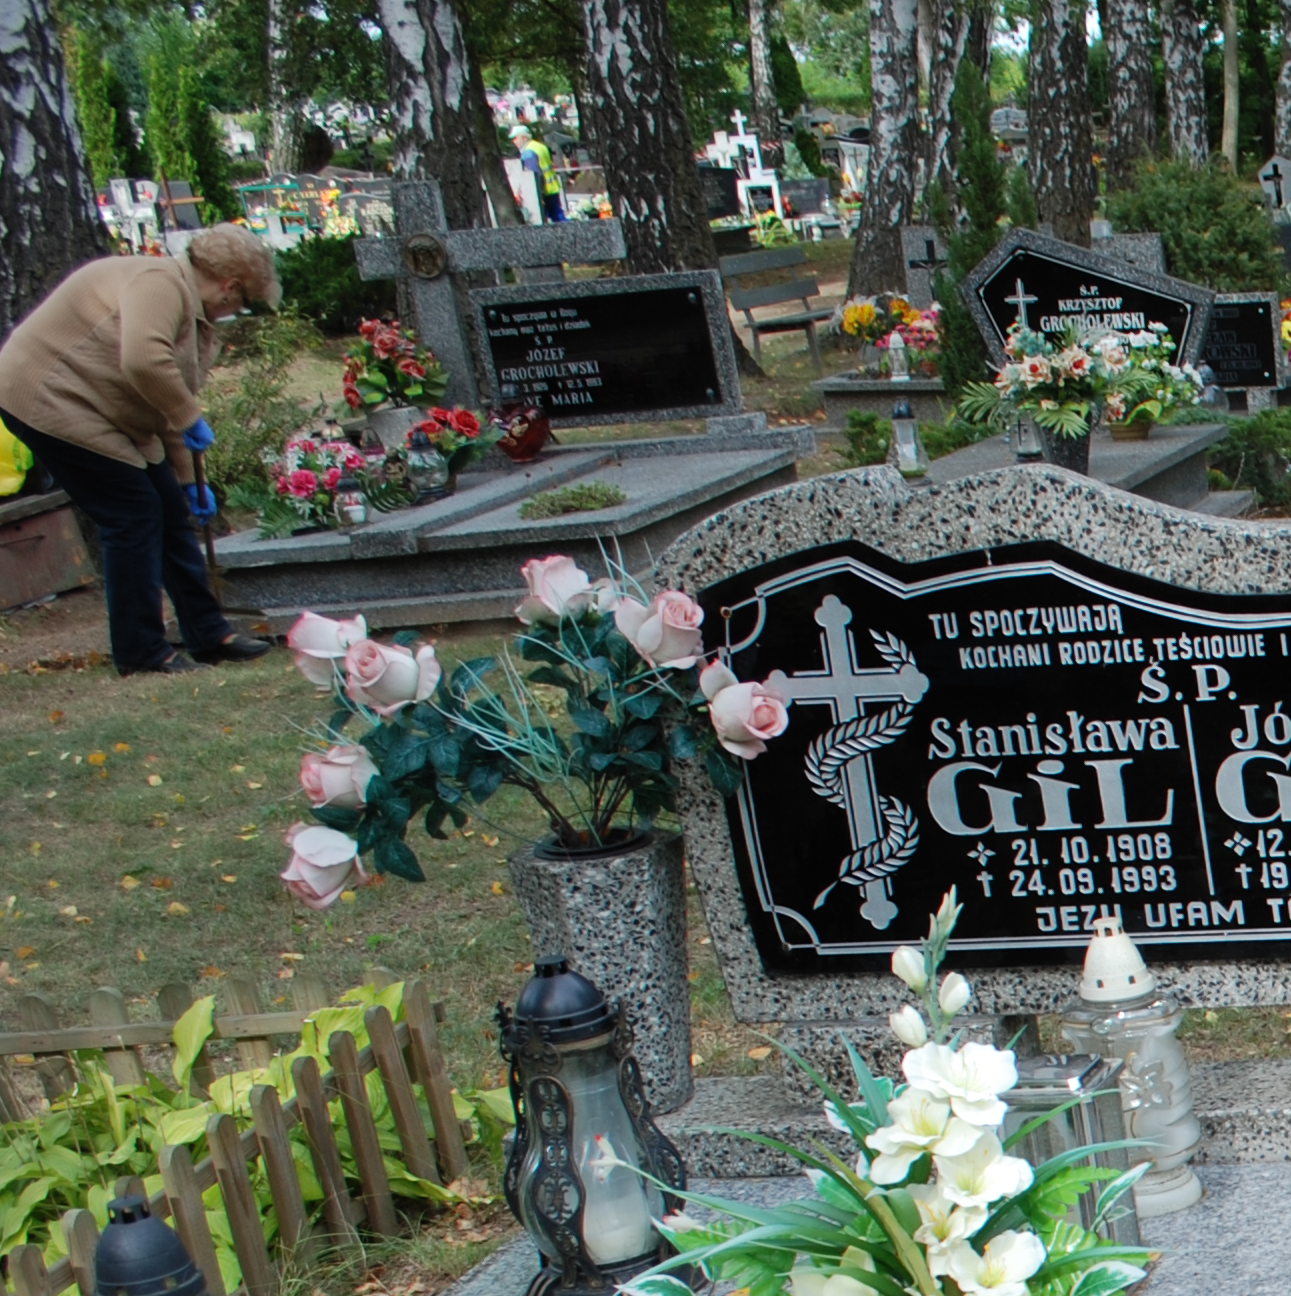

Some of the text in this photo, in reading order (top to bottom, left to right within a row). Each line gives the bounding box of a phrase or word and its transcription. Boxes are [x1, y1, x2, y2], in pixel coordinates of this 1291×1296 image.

[1058, 297, 1123, 312] KRZYSZTOF
[501, 360, 601, 382] GROCHOLEWSKI
[550, 391, 594, 406] MARIA
[928, 604, 1125, 640] TU SPOCZYWAJĄ
[958, 641, 1051, 670] KOCHANI
[1153, 630, 1266, 662] TEŚCIOWIE
[927, 709, 1180, 760] Stanisława
[1106, 832, 1173, 863] 1908
[1144, 899, 1245, 929] UFAM
